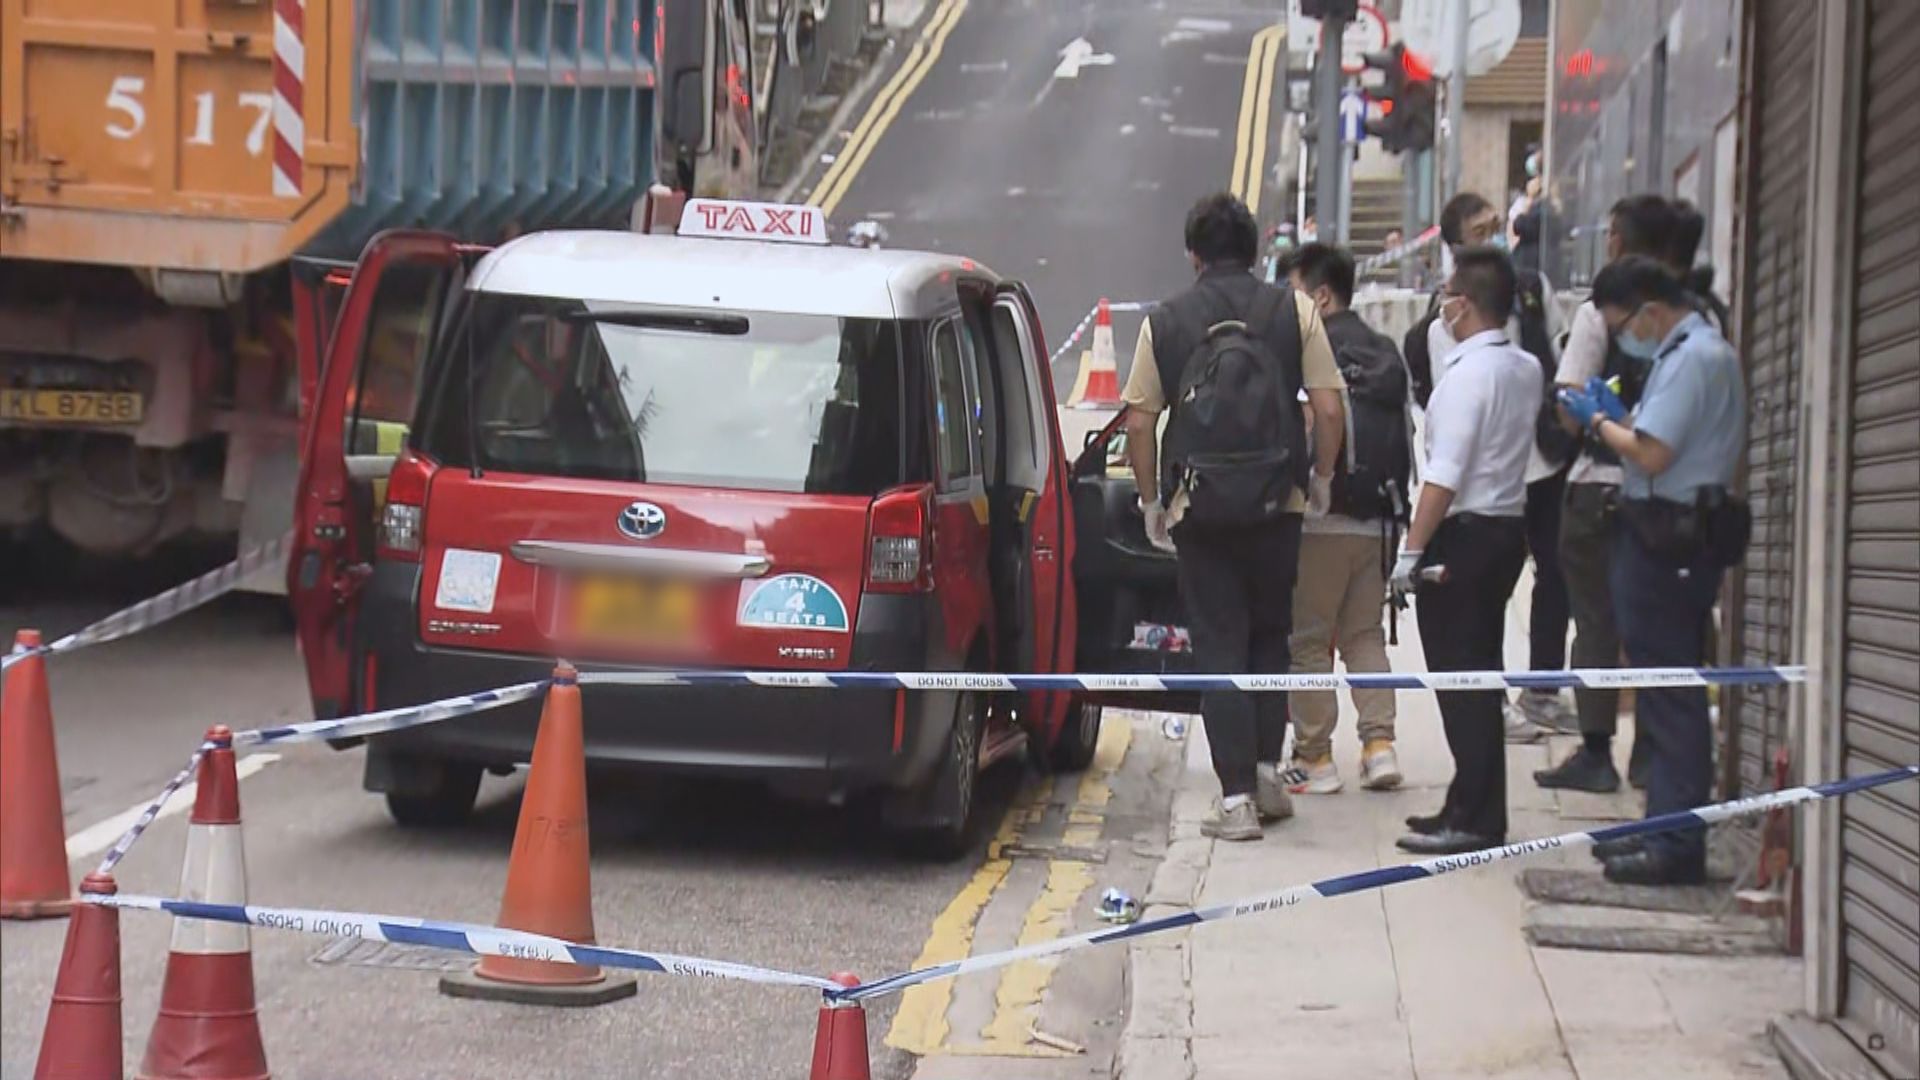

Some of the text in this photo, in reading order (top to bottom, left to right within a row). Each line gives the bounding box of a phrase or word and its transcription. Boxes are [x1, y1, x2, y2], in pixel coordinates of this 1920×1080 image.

[697, 204, 812, 236] TAXI
[777, 577, 819, 593] TAXI
[784, 591, 806, 612] 4
[763, 610, 827, 626] SEATS
[917, 676, 1004, 688] DO NOT CROSS
[1499, 841, 1534, 861] NOT
[1434, 848, 1494, 875] CROSS
[256, 911, 363, 939] DO NOT CROSS
